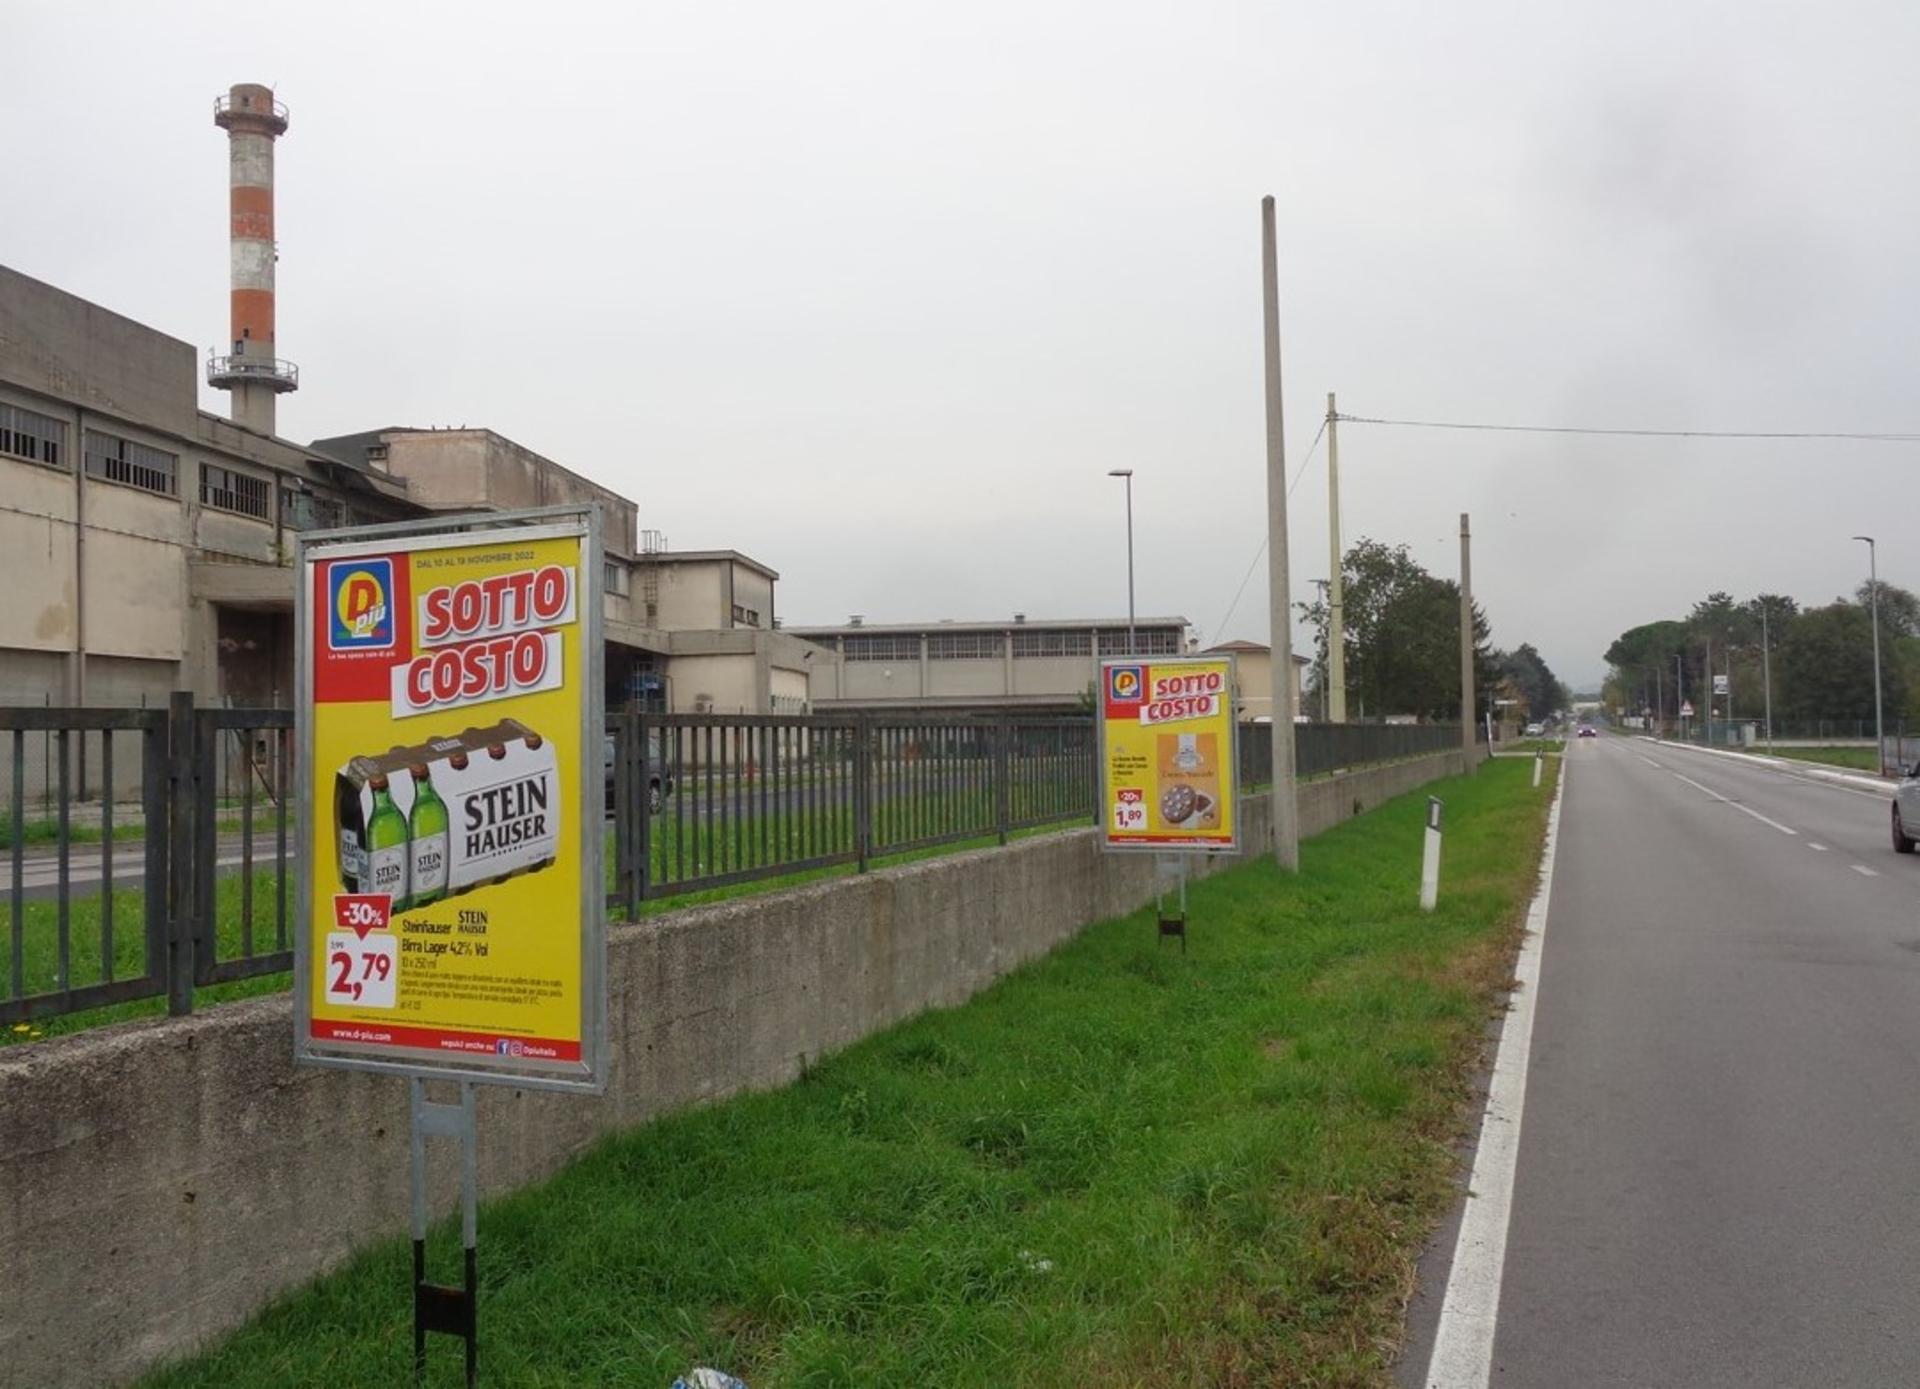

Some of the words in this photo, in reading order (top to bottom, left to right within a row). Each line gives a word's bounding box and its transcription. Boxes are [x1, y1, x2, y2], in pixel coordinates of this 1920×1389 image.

[416, 560, 432, 568] DAL
[467, 552, 512, 564] NOVEMBRE
[347, 579, 377, 621] D
[425, 565, 567, 639] SOTTO
[407, 632, 545, 707] COSTO
[1156, 672, 1220, 697] SOTTO
[1147, 696, 1211, 720] COSTO
[464, 775, 547, 831] STEIN
[1116, 810, 1142, 828] 1,89
[466, 814, 546, 858] HAUSER
[418, 852, 441, 867] STEIN
[376, 864, 401, 880] STEIN
[343, 902, 383, 925] -30%
[458, 910, 488, 924] STEIN
[402, 938, 422, 953] Birra
[423, 940, 448, 957] Lager
[331, 952, 391, 1000] 2,79
